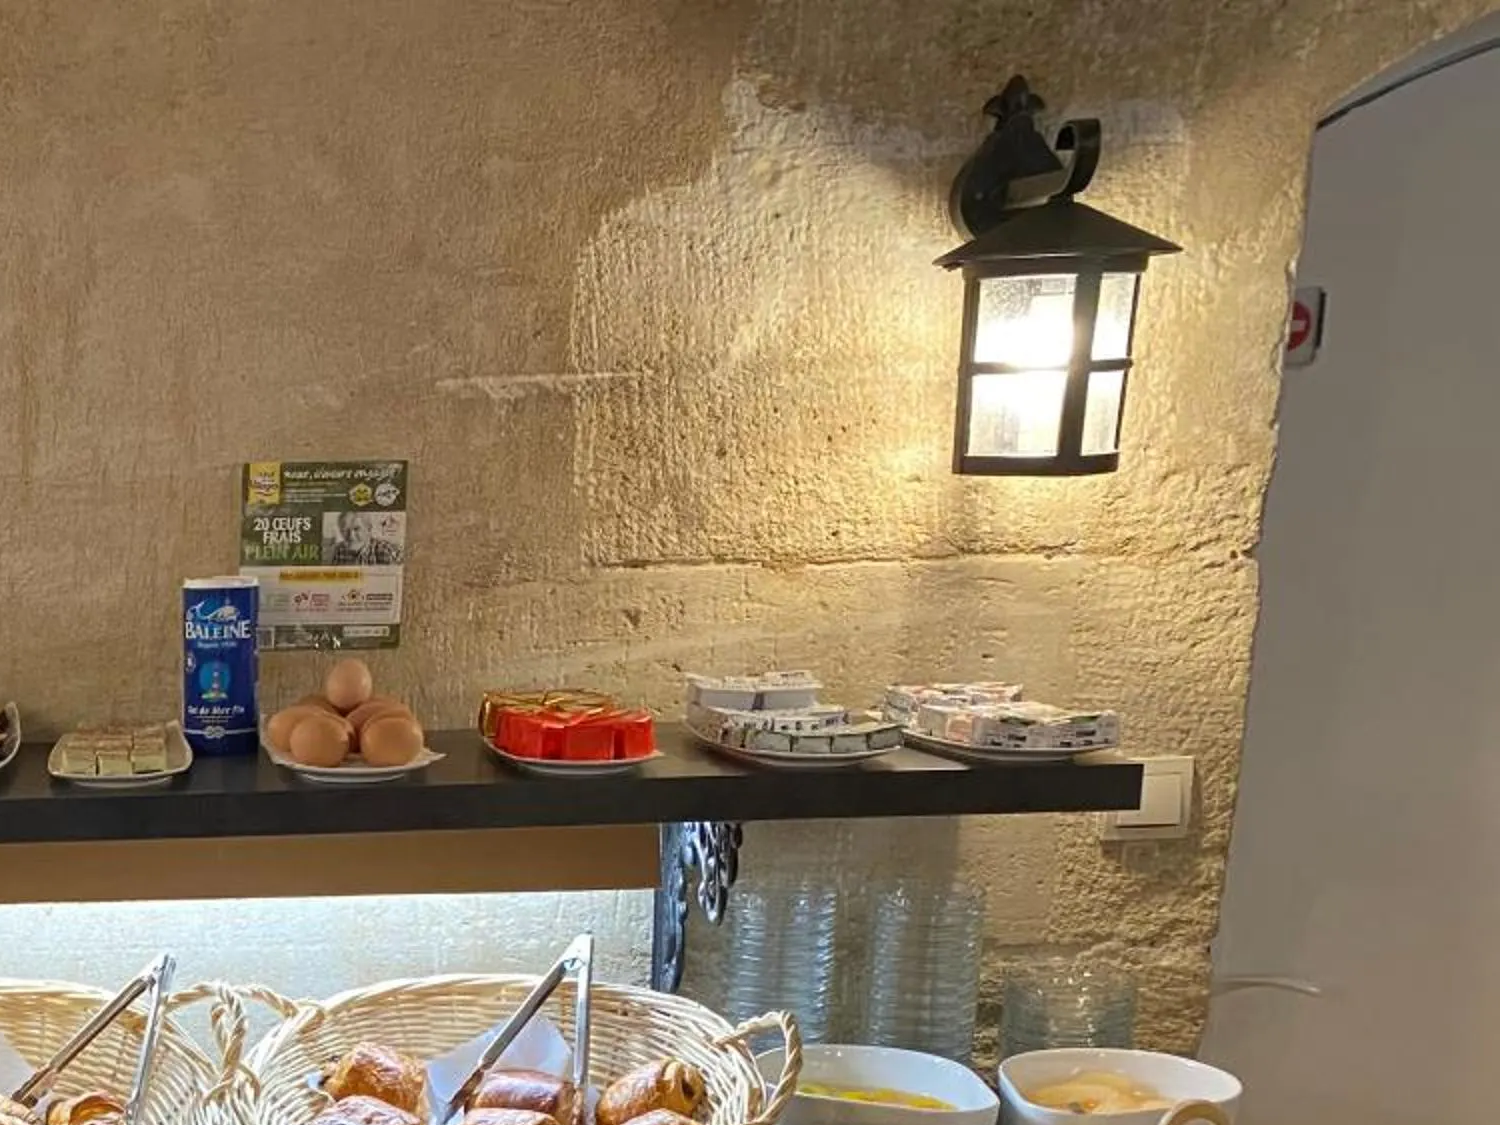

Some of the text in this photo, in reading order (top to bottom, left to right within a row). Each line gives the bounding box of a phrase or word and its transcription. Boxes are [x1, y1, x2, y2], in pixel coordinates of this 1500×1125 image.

[253, 517, 269, 532] 20
[262, 529, 303, 545] FRAIS
[244, 542, 320, 561] PLEIN AIR
[185, 619, 252, 640] BALEINE
